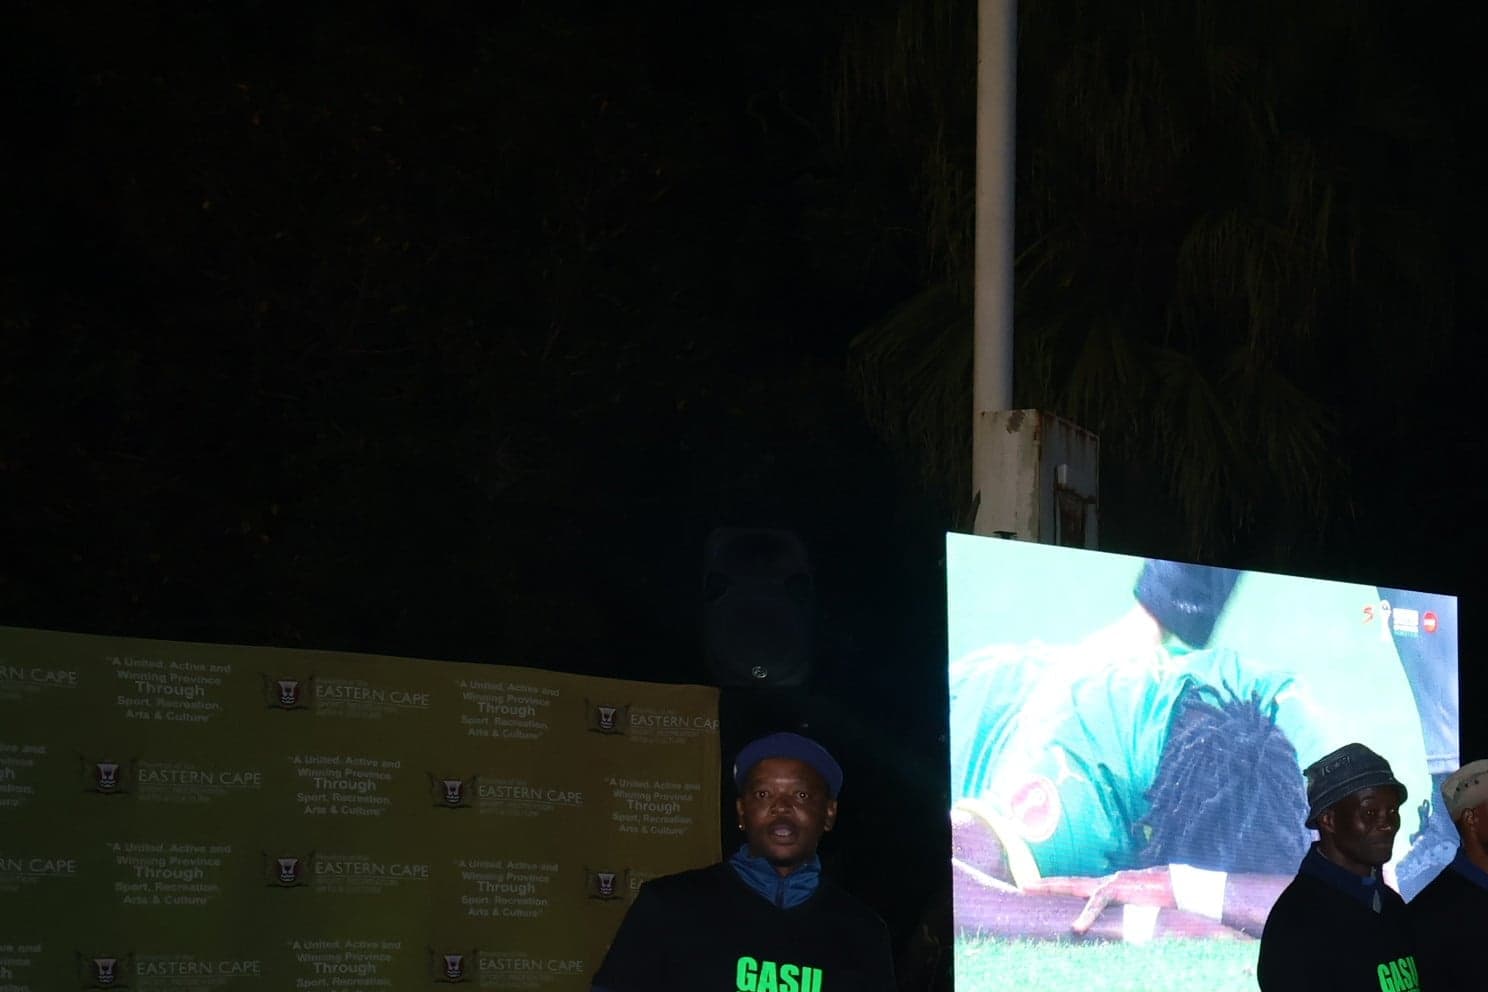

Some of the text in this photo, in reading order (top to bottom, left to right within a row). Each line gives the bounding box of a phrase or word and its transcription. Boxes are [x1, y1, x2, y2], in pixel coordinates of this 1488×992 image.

[208, 663, 231, 672] and
[31, 667, 79, 682] CAPE
[170, 673, 222, 686] Province
[136, 681, 205, 699] Through
[315, 686, 430, 706] EASTERN CAPE
[542, 687, 560, 697] and
[506, 694, 550, 706] Province
[126, 710, 150, 720] Arts
[478, 702, 535, 718] Through
[631, 713, 689, 728] EASTERN
[468, 729, 488, 738] Arts
[138, 769, 262, 786] EASTERN CAPE
[344, 769, 392, 780] Province
[312, 777, 376, 793] Through
[479, 784, 584, 804] EASTERN CAPE
[654, 791, 693, 801] Province
[304, 805, 326, 815] Arts
[627, 799, 680, 815] Through
[618, 824, 636, 833] Arts
[208, 844, 231, 854] and
[30, 858, 79, 873] CAPE
[169, 856, 221, 866] Province
[135, 865, 204, 882] Through
[315, 862, 430, 878] EASTERN CAPE
[506, 873, 549, 883] Province
[478, 880, 535, 896] Through
[123, 895, 148, 905] Arts
[468, 907, 489, 917] Arts
[345, 951, 392, 961] Province
[136, 959, 262, 976] EASTERN CAPE
[312, 961, 376, 976] Through
[479, 959, 584, 973] EASTERN CAPE
